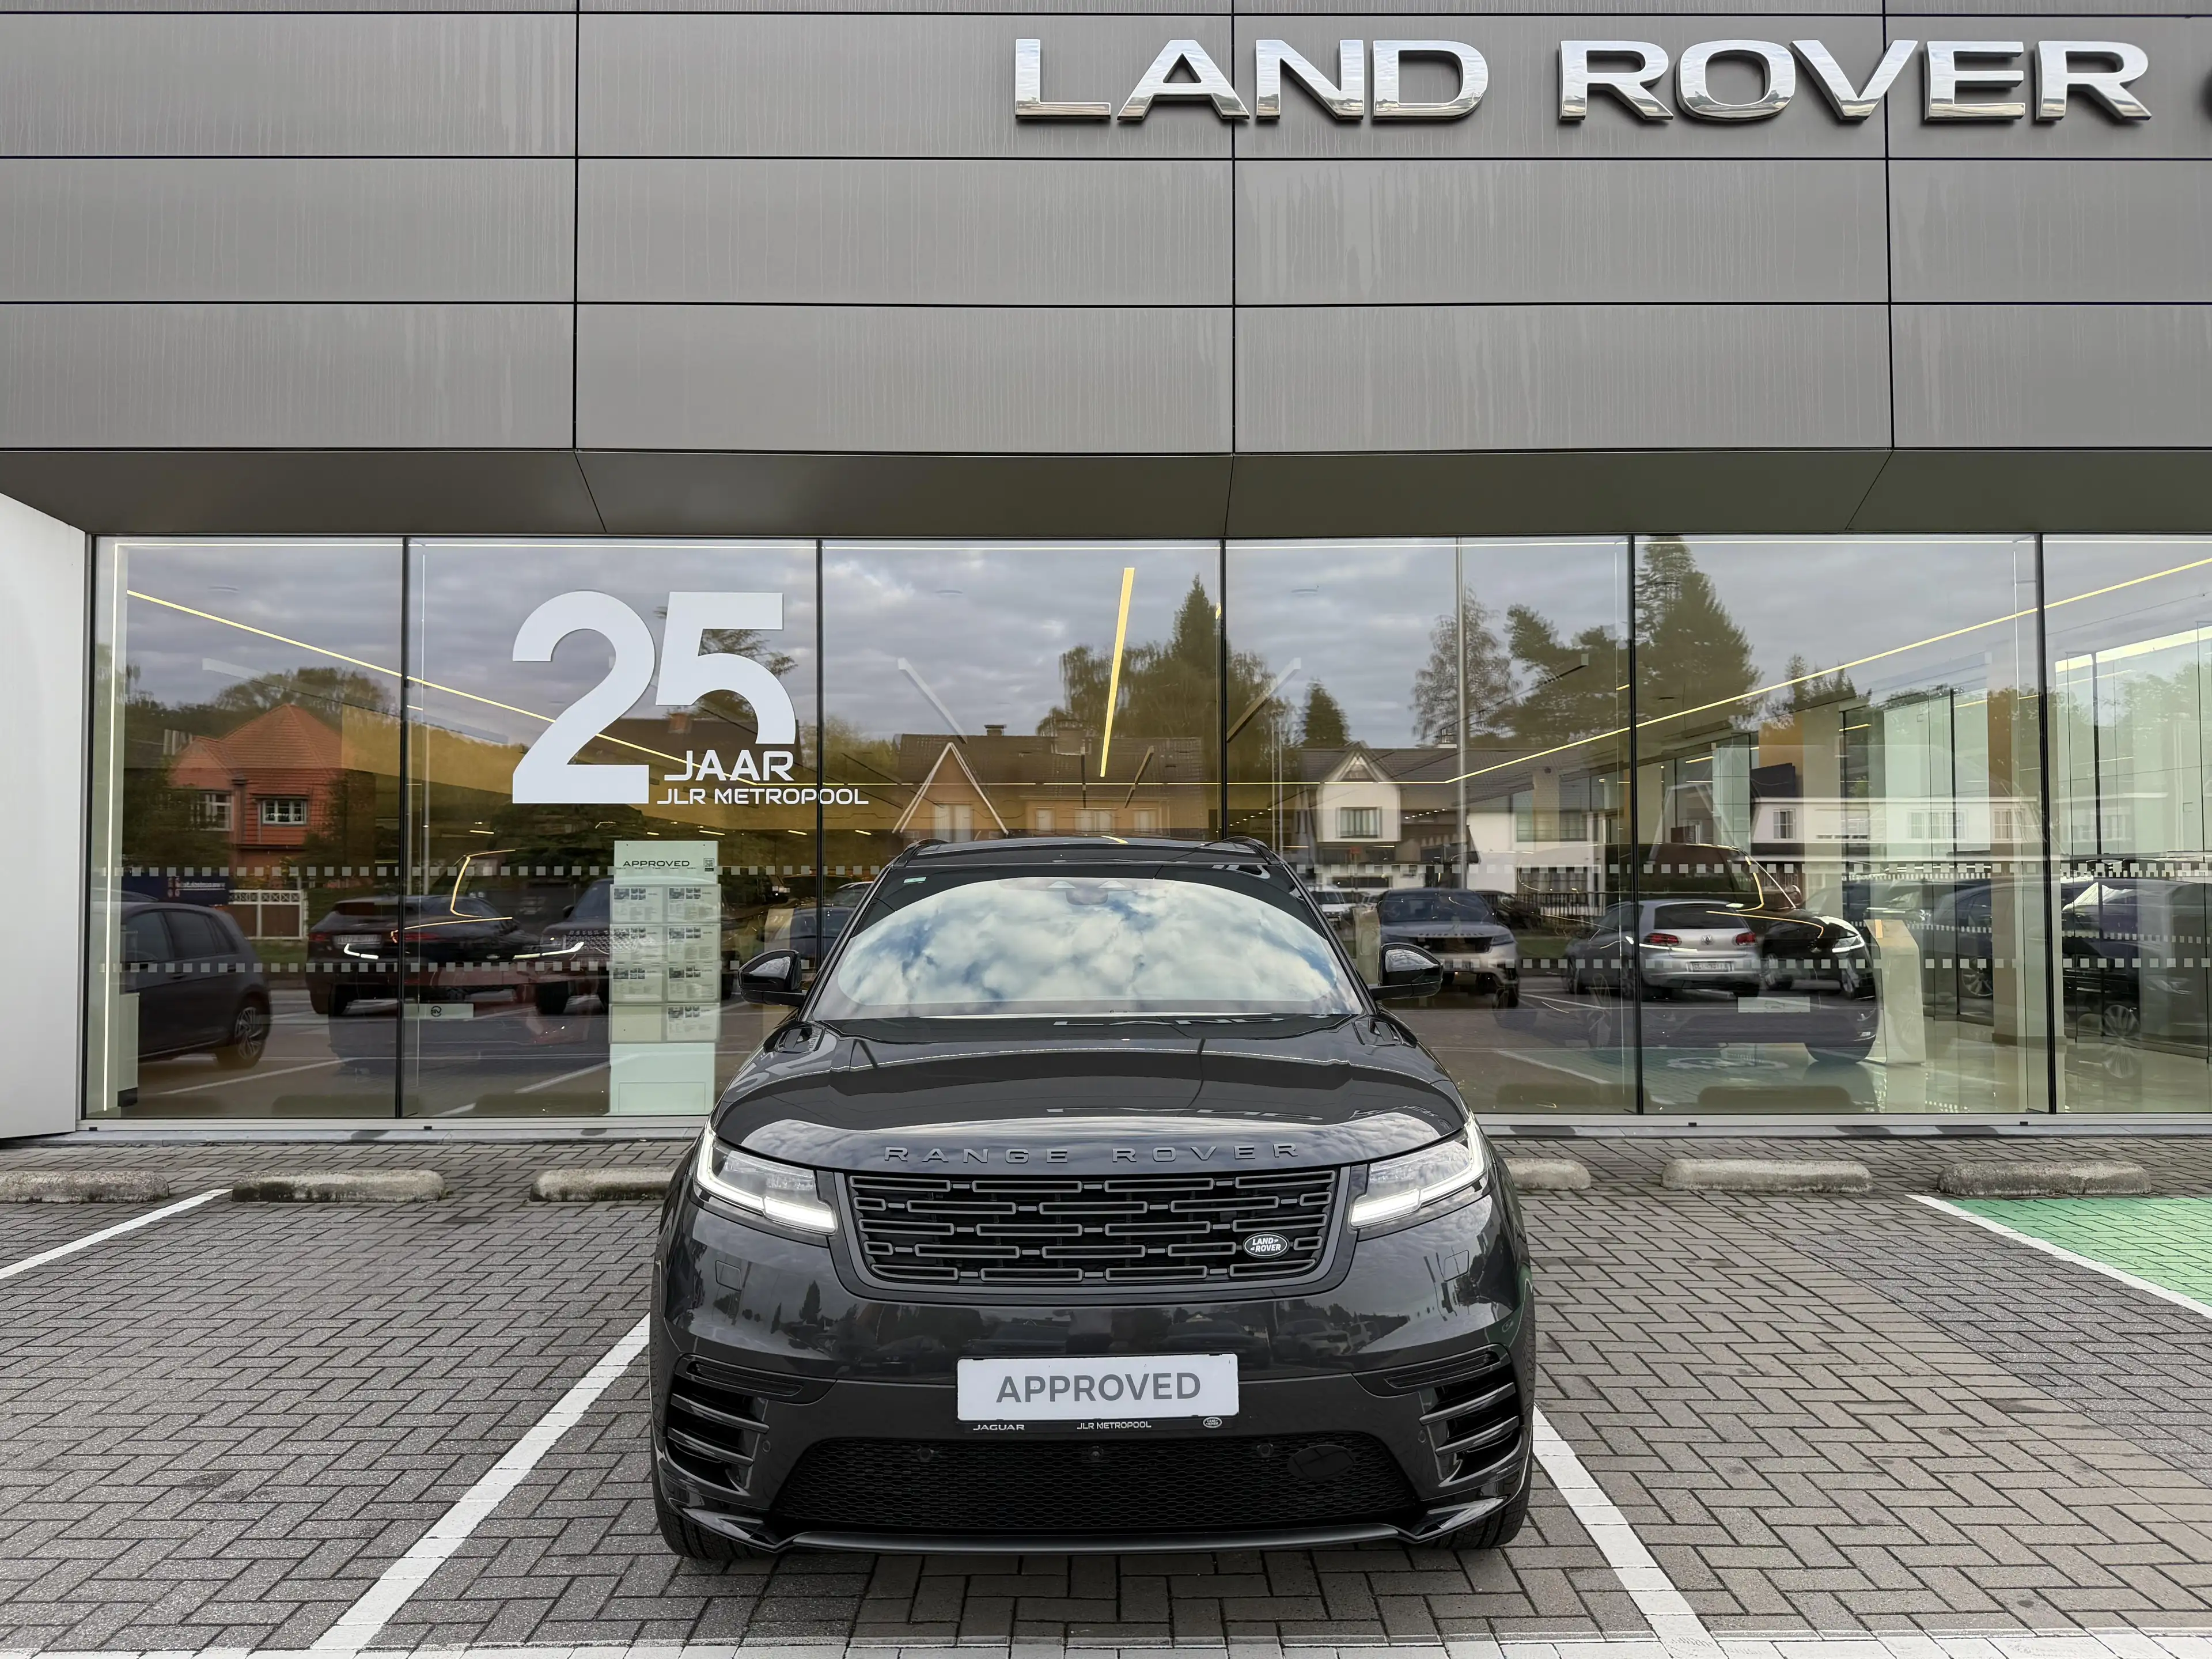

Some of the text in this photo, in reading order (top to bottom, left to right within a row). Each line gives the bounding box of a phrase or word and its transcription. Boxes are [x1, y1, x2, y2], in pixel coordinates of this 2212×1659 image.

[1015, 38, 2152, 122] LAND ROVER
[512, 590, 796, 804] 25
[664, 749, 794, 782] JAAR
[657, 787, 869, 805] JLR METROPOOL
[883, 1142, 1300, 1164] RANGE ROVER
[1252, 1237, 1274, 1245] LAND
[1255, 1244, 1281, 1253] ROVER
[995, 1372, 1202, 1403] APPROVED
[1096, 1421, 1152, 1430] METROPOOL
